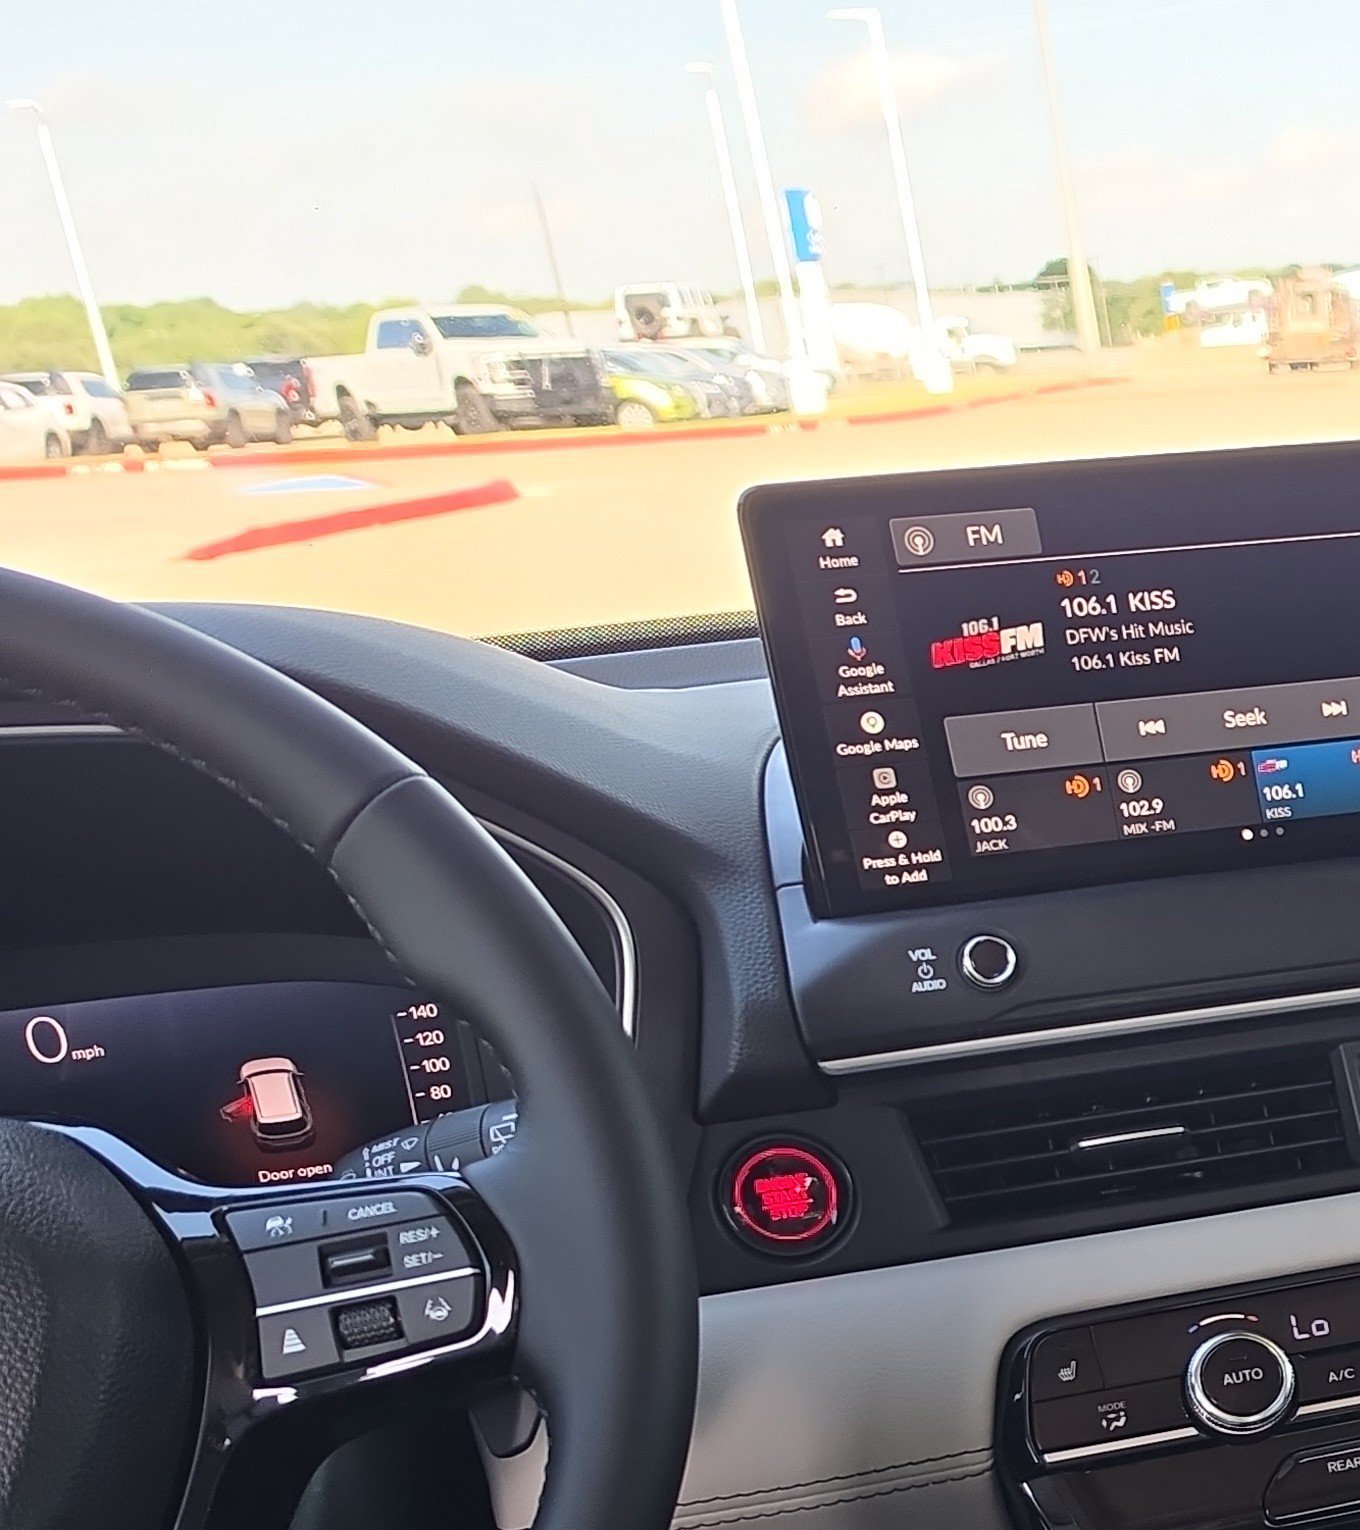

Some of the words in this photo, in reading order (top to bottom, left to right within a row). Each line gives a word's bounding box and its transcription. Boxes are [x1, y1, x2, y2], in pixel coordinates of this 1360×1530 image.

[967, 526, 1003, 546] FM
[819, 556, 859, 569] Home
[1060, 594, 1117, 618] 106.1
[1128, 589, 1176, 612] KISS
[835, 612, 868, 626] Back
[961, 616, 999, 638] 106.1
[1065, 627, 1119, 645] DFW's
[1122, 623, 1145, 641] Hit
[1148, 619, 1194, 638] Music
[1071, 653, 1115, 672] 106.1
[1119, 651, 1151, 667] Kiss
[1154, 646, 1180, 664] FM
[839, 663, 885, 678] Google
[838, 681, 895, 697] Assistant
[1224, 708, 1267, 729] Seek
[837, 741, 883, 756] Google
[884, 738, 919, 751] Maps
[1002, 730, 1048, 750] Tune
[871, 792, 909, 807] Apple
[1262, 783, 1304, 802] 106.1
[1119, 798, 1164, 818] 102.9
[1265, 806, 1292, 820] KISS
[869, 810, 916, 825] CarPlay
[970, 814, 1018, 834] 100.3
[1123, 822, 1148, 836] MIX
[975, 838, 1009, 853] JACK
[863, 856, 897, 870] Press
[899, 855, 910, 866] &
[911, 849, 943, 863] Hold
[884, 873, 899, 886] to
[901, 869, 929, 884] Add
[908, 948, 937, 962] VOL
[911, 978, 947, 993] AUDIO
[408, 1003, 438, 1020] 140
[25, 1015, 69, 1064] 0
[71, 1044, 105, 1062] mph
[415, 1029, 444, 1046] 120
[421, 1056, 450, 1073] 100
[429, 1084, 452, 1100] 80
[371, 1137, 400, 1153] MIST
[371, 1151, 396, 1167] OFF
[258, 1166, 293, 1183] Door
[298, 1163, 333, 1182] open
[348, 1201, 397, 1220] CANCEL
[399, 1225, 441, 1246] RES/+
[1290, 1315, 1330, 1340] Lo
[1222, 1367, 1264, 1386] AUTO
[1328, 1368, 1355, 1383] A/C
[1097, 1401, 1127, 1412] MODE
